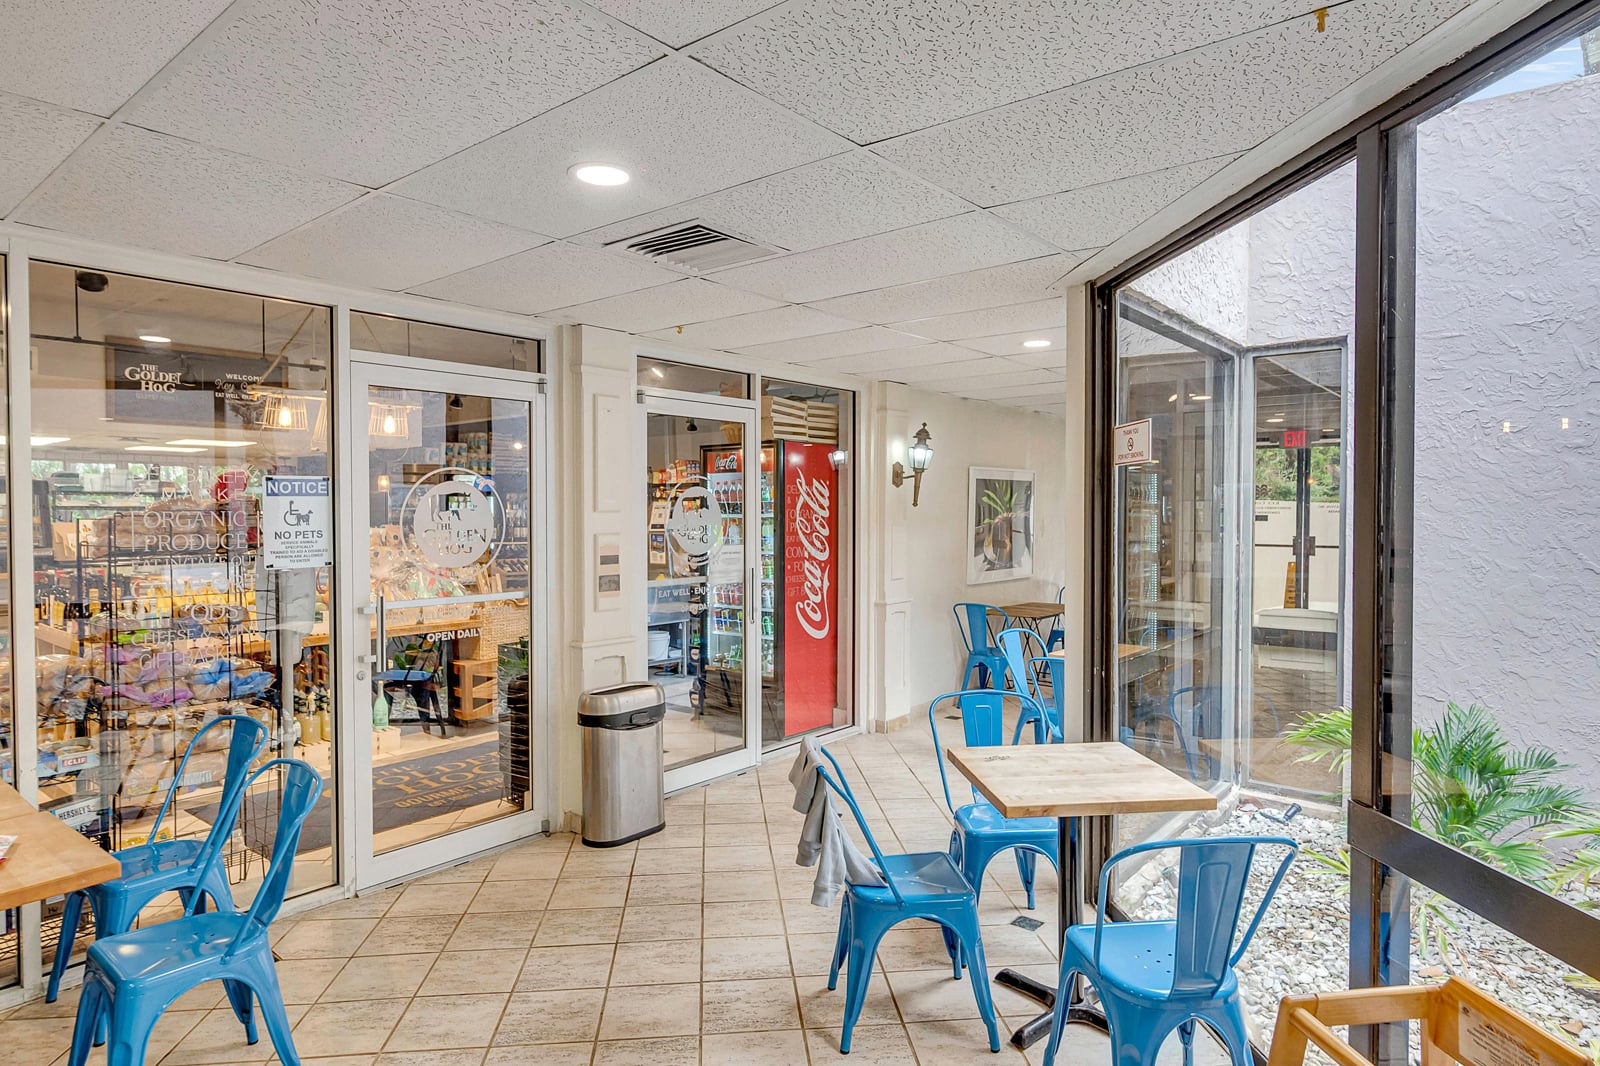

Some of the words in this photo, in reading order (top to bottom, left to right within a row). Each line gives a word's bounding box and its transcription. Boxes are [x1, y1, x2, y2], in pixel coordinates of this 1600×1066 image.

[140, 364, 158, 372] THE
[1284, 431, 1307, 447] EXIT
[267, 481, 328, 494] NOTICE
[143, 511, 247, 528] ORGANIC
[143, 533, 248, 552] PRODUCE
[274, 531, 291, 540] NO
[295, 530, 323, 539] PETS
[796, 467, 830, 639] Coca-Cola
[658, 590, 670, 598] EAT
[672, 588, 690, 596] WELL
[427, 631, 455, 642] OPEN
[457, 628, 483, 639] DAILY
[58, 804, 92, 820] HERSHEY'S
